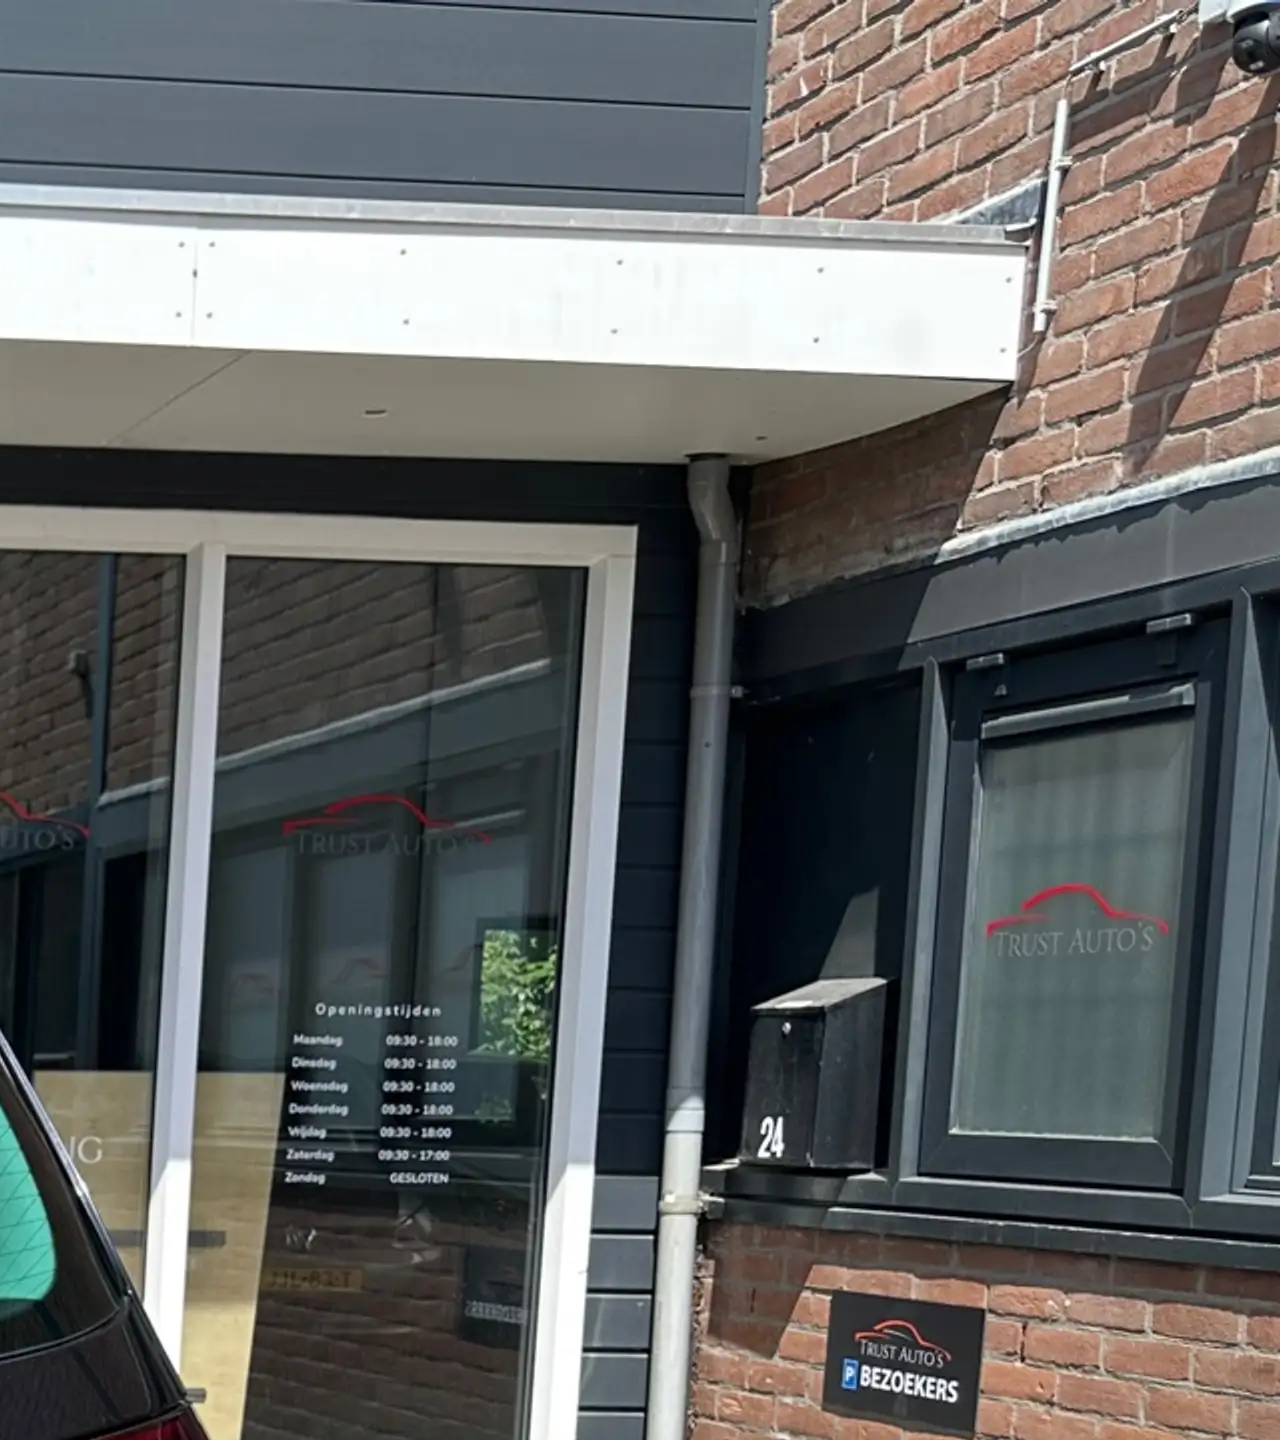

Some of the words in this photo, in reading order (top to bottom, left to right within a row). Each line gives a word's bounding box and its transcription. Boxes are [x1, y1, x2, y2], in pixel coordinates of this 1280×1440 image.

[291, 829, 376, 854] TRUST
[994, 931, 1064, 957] TRUST
[1067, 921, 1154, 954] AUTO'S
[315, 1002, 441, 1019] Openingstijden
[293, 1034, 343, 1047] Maandag
[386, 1035, 417, 1047] 09:30
[427, 1035, 458, 1047] 18:00
[292, 1057, 337, 1070] Dinsdag
[384, 1058, 415, 1069] 09:30
[426, 1058, 457, 1069] 18:00
[291, 1080, 348, 1093] Woensdag
[382, 1081, 414, 1092] 09:30
[424, 1081, 455, 1092] 18:00
[289, 1103, 349, 1116] Donderdag
[381, 1104, 412, 1115] 09:30
[422, 1104, 454, 1115] 18:00
[288, 1126, 327, 1139] Vrijdag
[380, 1127, 411, 1138] 09:30
[421, 1127, 452, 1138] 18:00
[757, 1116, 785, 1158] 24
[286, 1149, 335, 1162] Zaterdag
[378, 1150, 409, 1161] 09:30
[419, 1150, 450, 1161] 17:00
[285, 1172, 326, 1185] Zondag
[390, 1173, 449, 1184] GESLOTEN
[859, 1340, 896, 1361] TRUST
[898, 1346, 945, 1369] AUTO'S
[860, 1364, 960, 1404] BEZOEKERS
